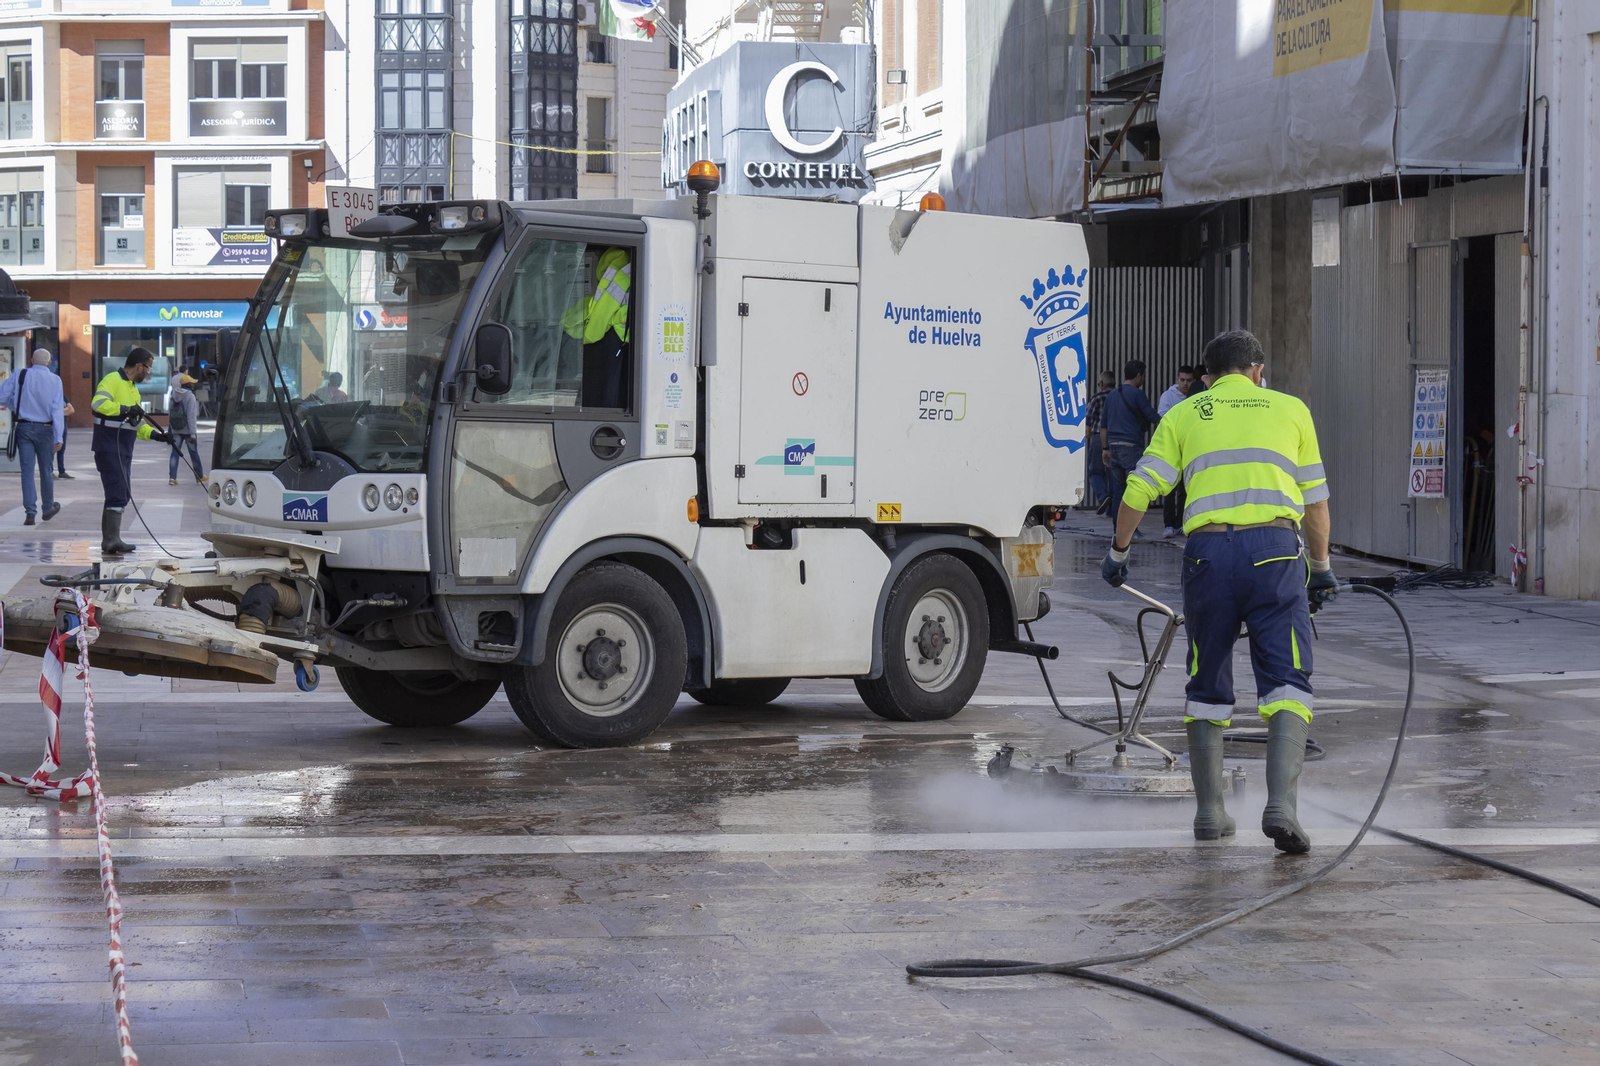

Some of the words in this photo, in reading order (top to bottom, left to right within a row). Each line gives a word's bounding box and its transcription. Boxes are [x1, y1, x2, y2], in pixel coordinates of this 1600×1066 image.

[1276, 31, 1286, 57] DE
[1288, 28, 1297, 54] LA
[1298, 17, 1331, 50] CULTURA
[201, 117, 238, 126] ASESORÍA
[241, 117, 276, 127] JURÍDICA
[743, 161, 862, 179] CORTEFIEL
[331, 191, 340, 208] E
[343, 191, 374, 211] 3045
[345, 216, 366, 232] BC
[181, 309, 223, 319] movistar
[883, 301, 982, 325] Ayuntamiento
[664, 321, 684, 337] IM
[908, 325, 927, 344] de
[931, 326, 981, 347] Huelva
[1046, 333, 1055, 343] ET
[664, 343, 684, 353] BLE
[1039, 354, 1048, 383] MARIS
[919, 390, 945, 405] pre
[1044, 386, 1054, 423] PORTUS
[918, 408, 954, 421] zero
[788, 451, 807, 462] CMA
[291, 508, 319, 521] CMAR
